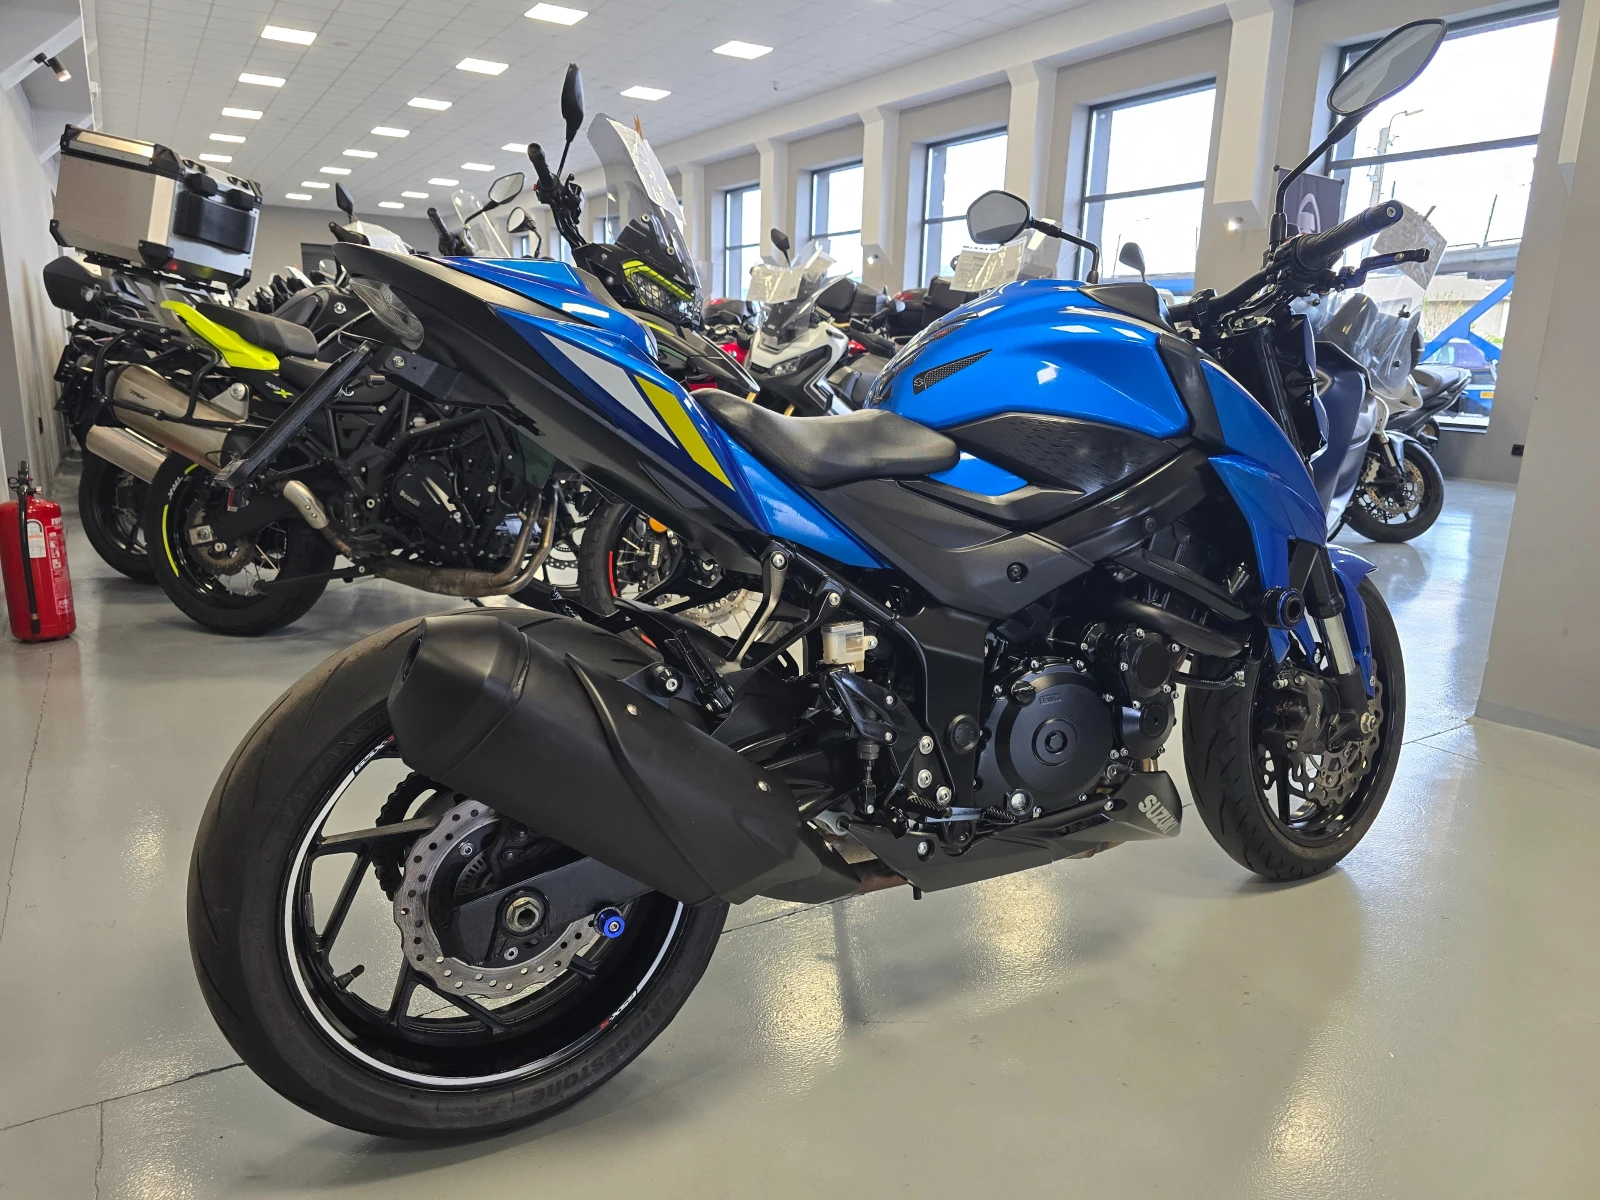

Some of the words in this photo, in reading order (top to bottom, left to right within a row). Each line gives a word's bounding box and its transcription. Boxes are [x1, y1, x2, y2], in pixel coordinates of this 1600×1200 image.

[129, 388, 148, 401] TRK
[399, 489, 421, 508] Benelli
[651, 543, 661, 566] Benelli
[1138, 794, 1178, 835] SUZUKI
